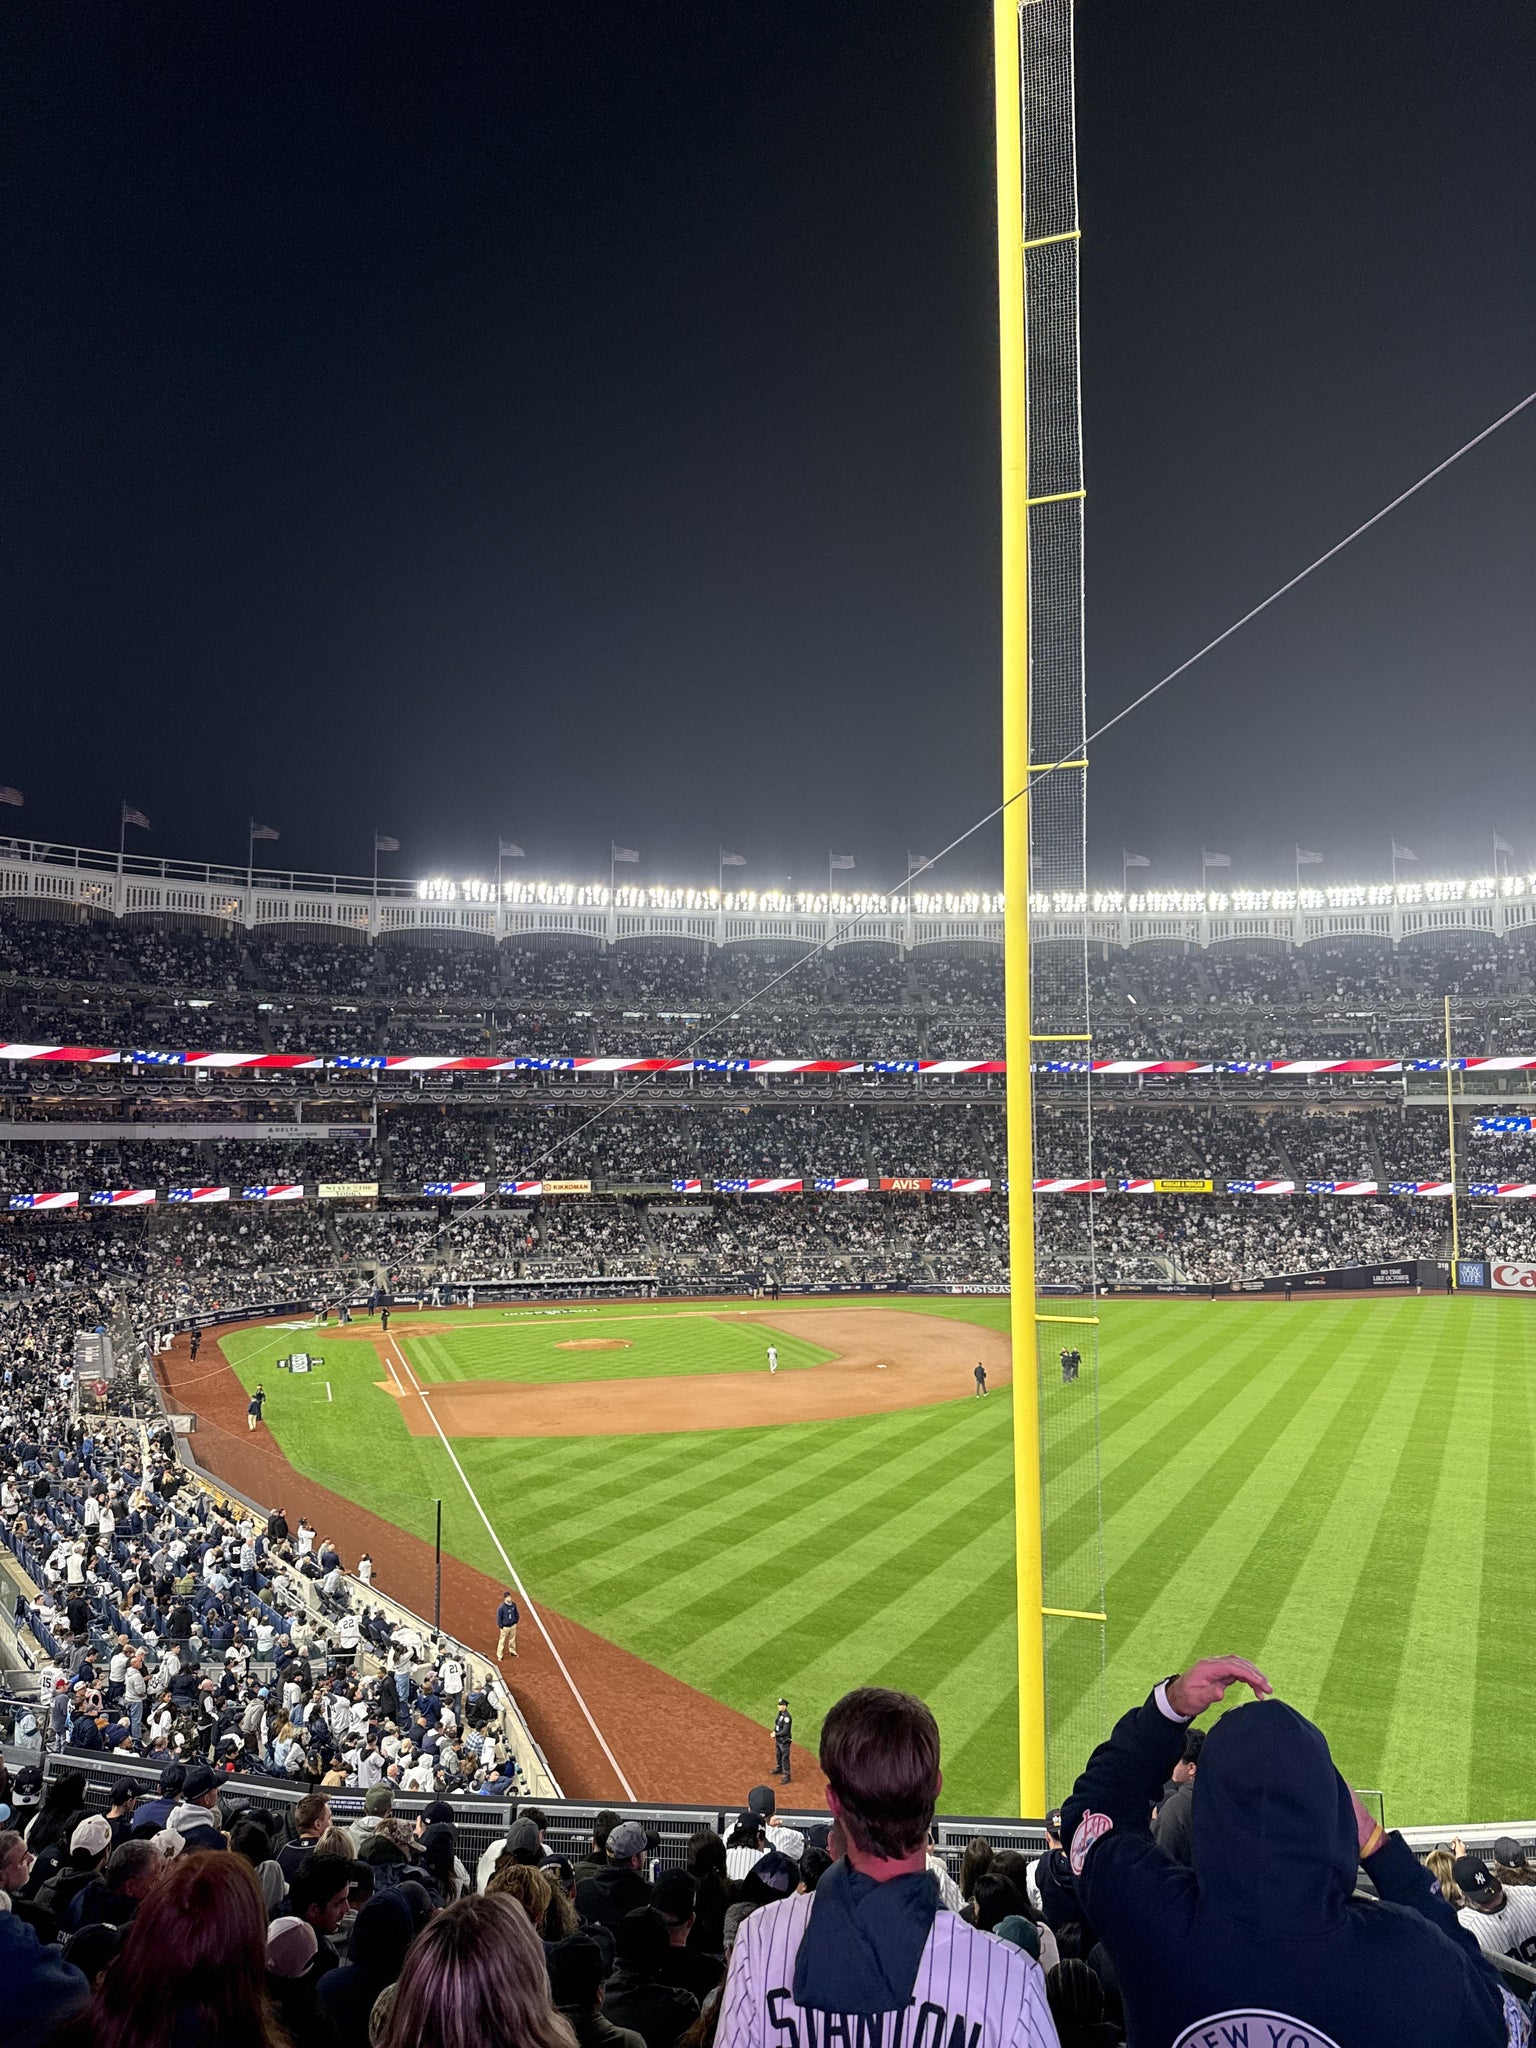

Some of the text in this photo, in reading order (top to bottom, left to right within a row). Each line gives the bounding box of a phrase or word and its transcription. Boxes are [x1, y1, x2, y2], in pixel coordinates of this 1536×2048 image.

[891, 1180, 920, 1190] AVIS
[1462, 1265, 1480, 1273] NEW
[1460, 1270, 1481, 1278] YORK
[963, 1285, 1011, 1294] POSTSEAS
[232, 1546, 241, 1555] 15
[342, 1618, 355, 1630] 22
[449, 1663, 460, 1674] 21
[42, 1676, 52, 1688] 15
